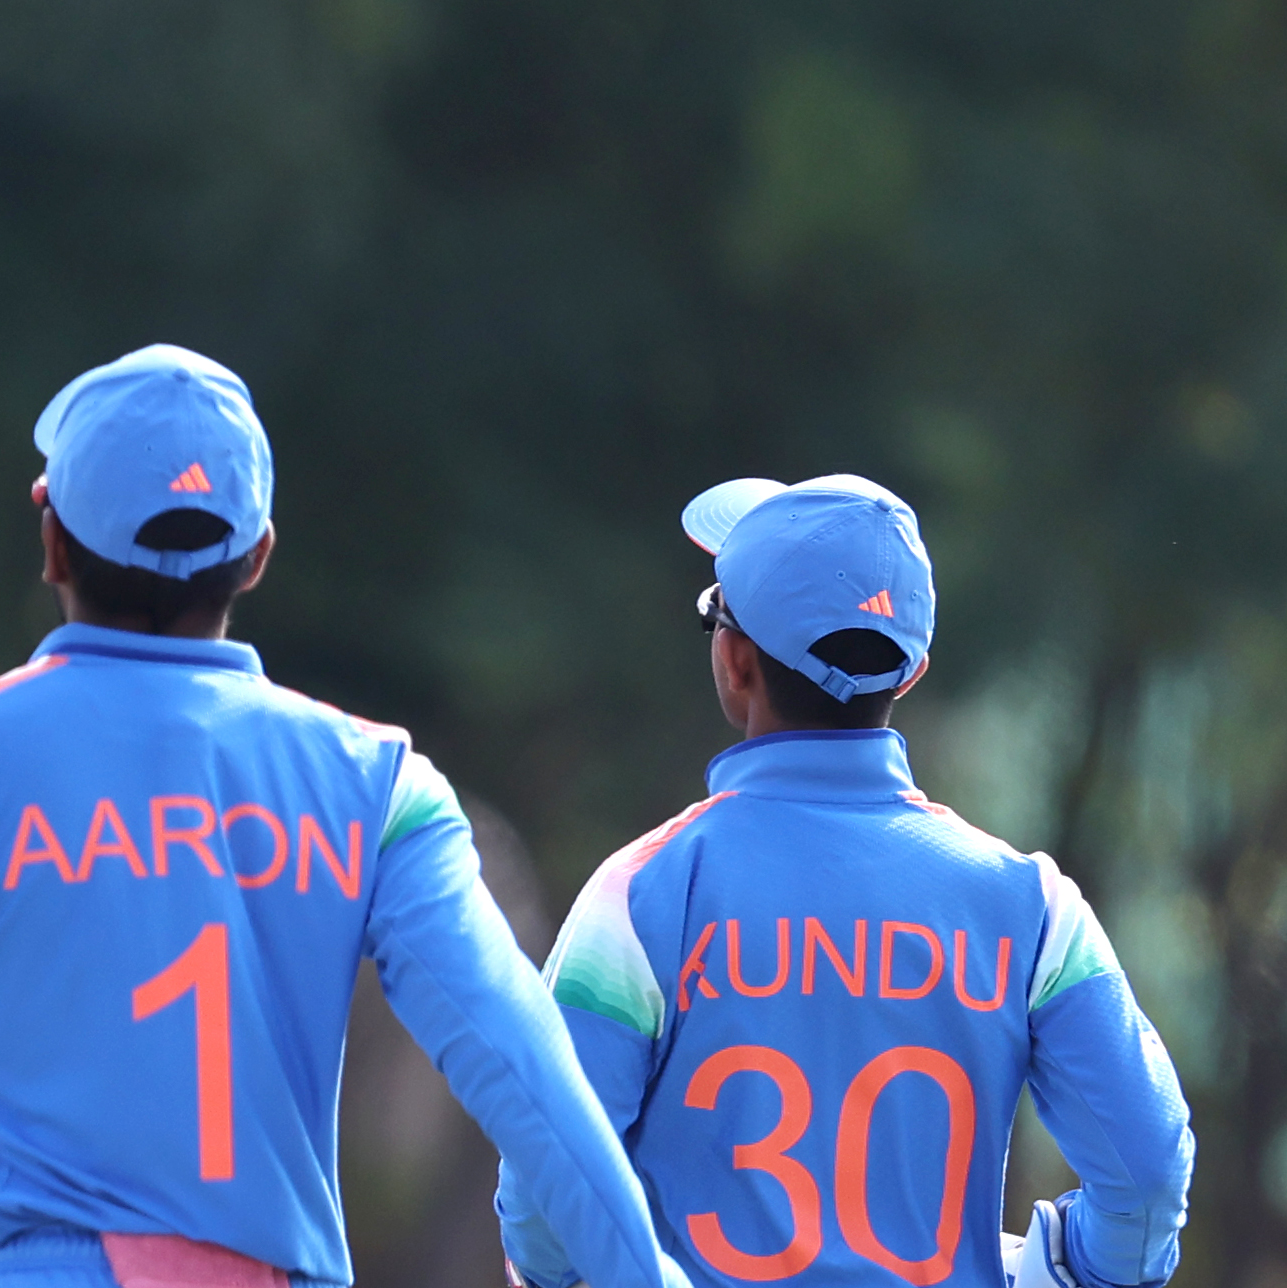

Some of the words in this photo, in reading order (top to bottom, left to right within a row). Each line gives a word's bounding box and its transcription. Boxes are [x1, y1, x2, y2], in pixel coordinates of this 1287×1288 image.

[3, 794, 362, 901] AARON
[677, 917, 1012, 1012] KUNDU
[131, 922, 234, 1182] 1
[683, 1045, 976, 1287] 30
